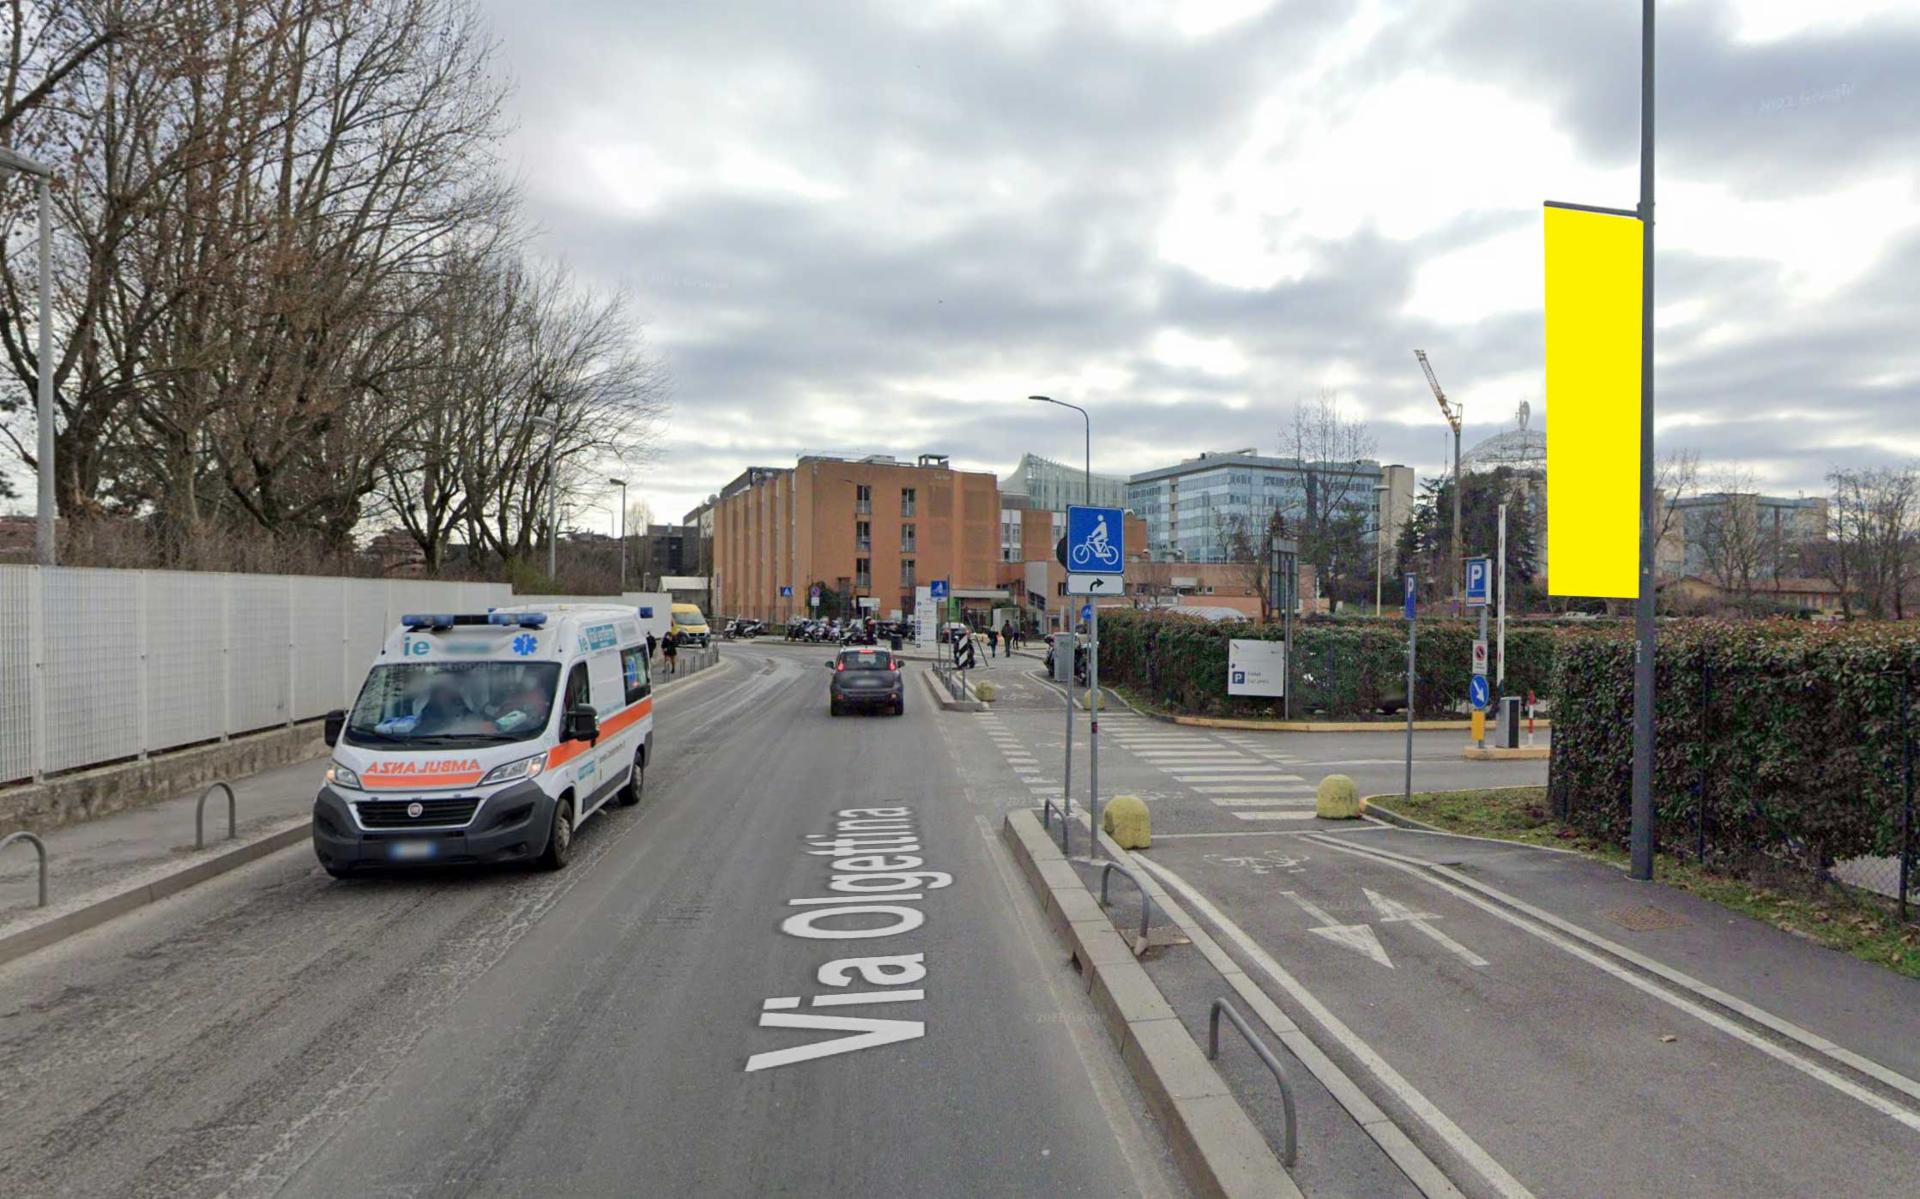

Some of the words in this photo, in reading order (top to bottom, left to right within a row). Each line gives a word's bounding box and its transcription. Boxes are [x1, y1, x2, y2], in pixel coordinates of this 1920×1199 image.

[1407, 576, 1414, 598] P
[1470, 564, 1483, 589] P
[403, 636, 431, 656] ie
